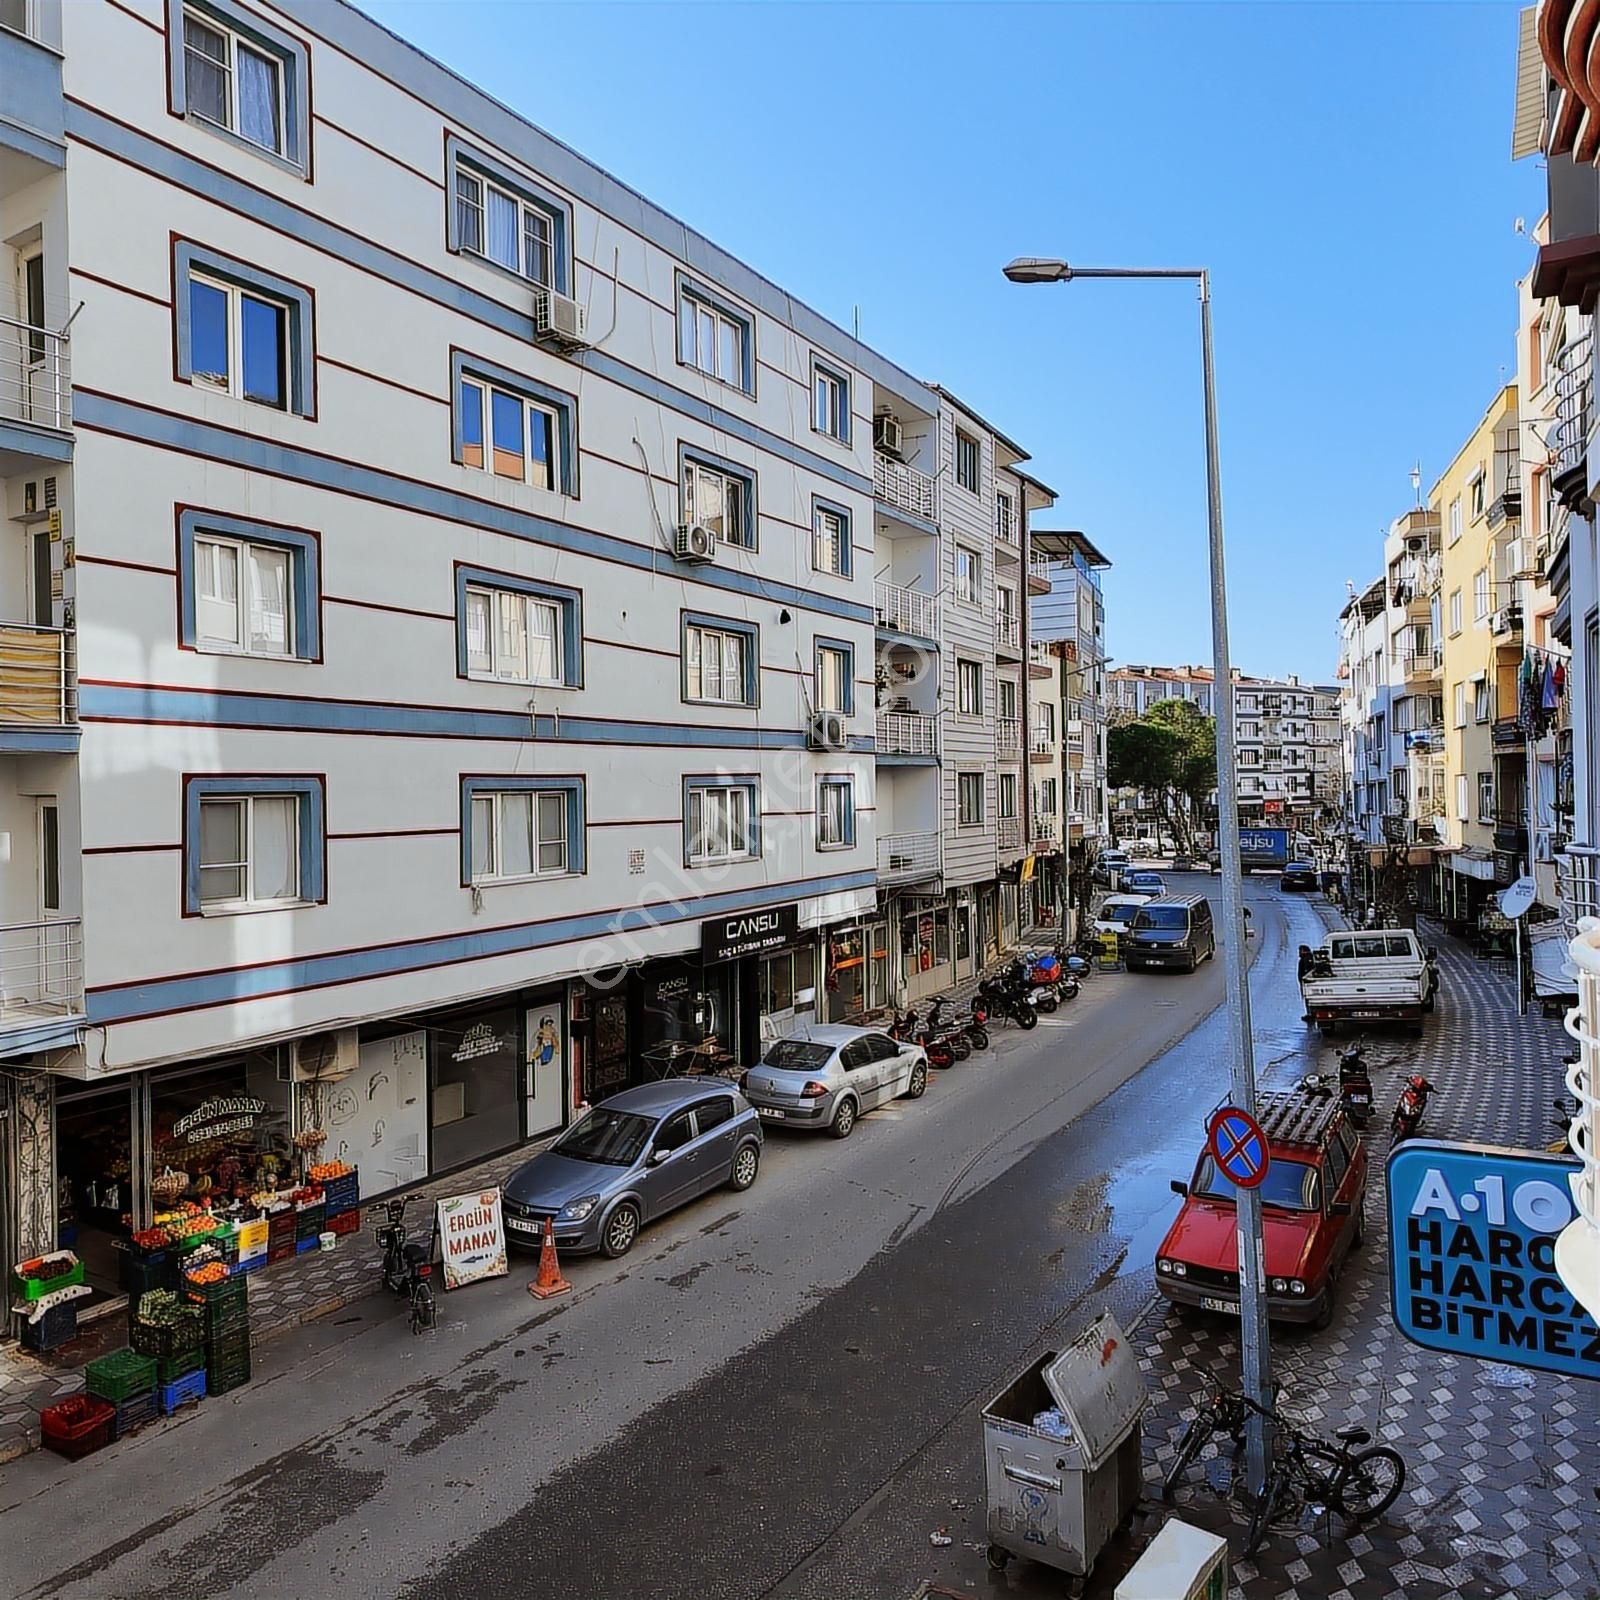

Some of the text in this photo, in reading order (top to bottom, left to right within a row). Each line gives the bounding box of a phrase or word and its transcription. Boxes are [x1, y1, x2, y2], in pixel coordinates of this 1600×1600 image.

[726, 912, 779, 939] CANSU
[173, 1097, 265, 1138] ERGÜN MANAV
[449, 1207, 493, 1233] ERGÜN
[1411, 1168, 1572, 1233] A.10
[448, 1229, 497, 1256] MANAV
[1407, 1217, 1556, 1274] HARC
[1408, 1256, 1590, 1320] HARC
